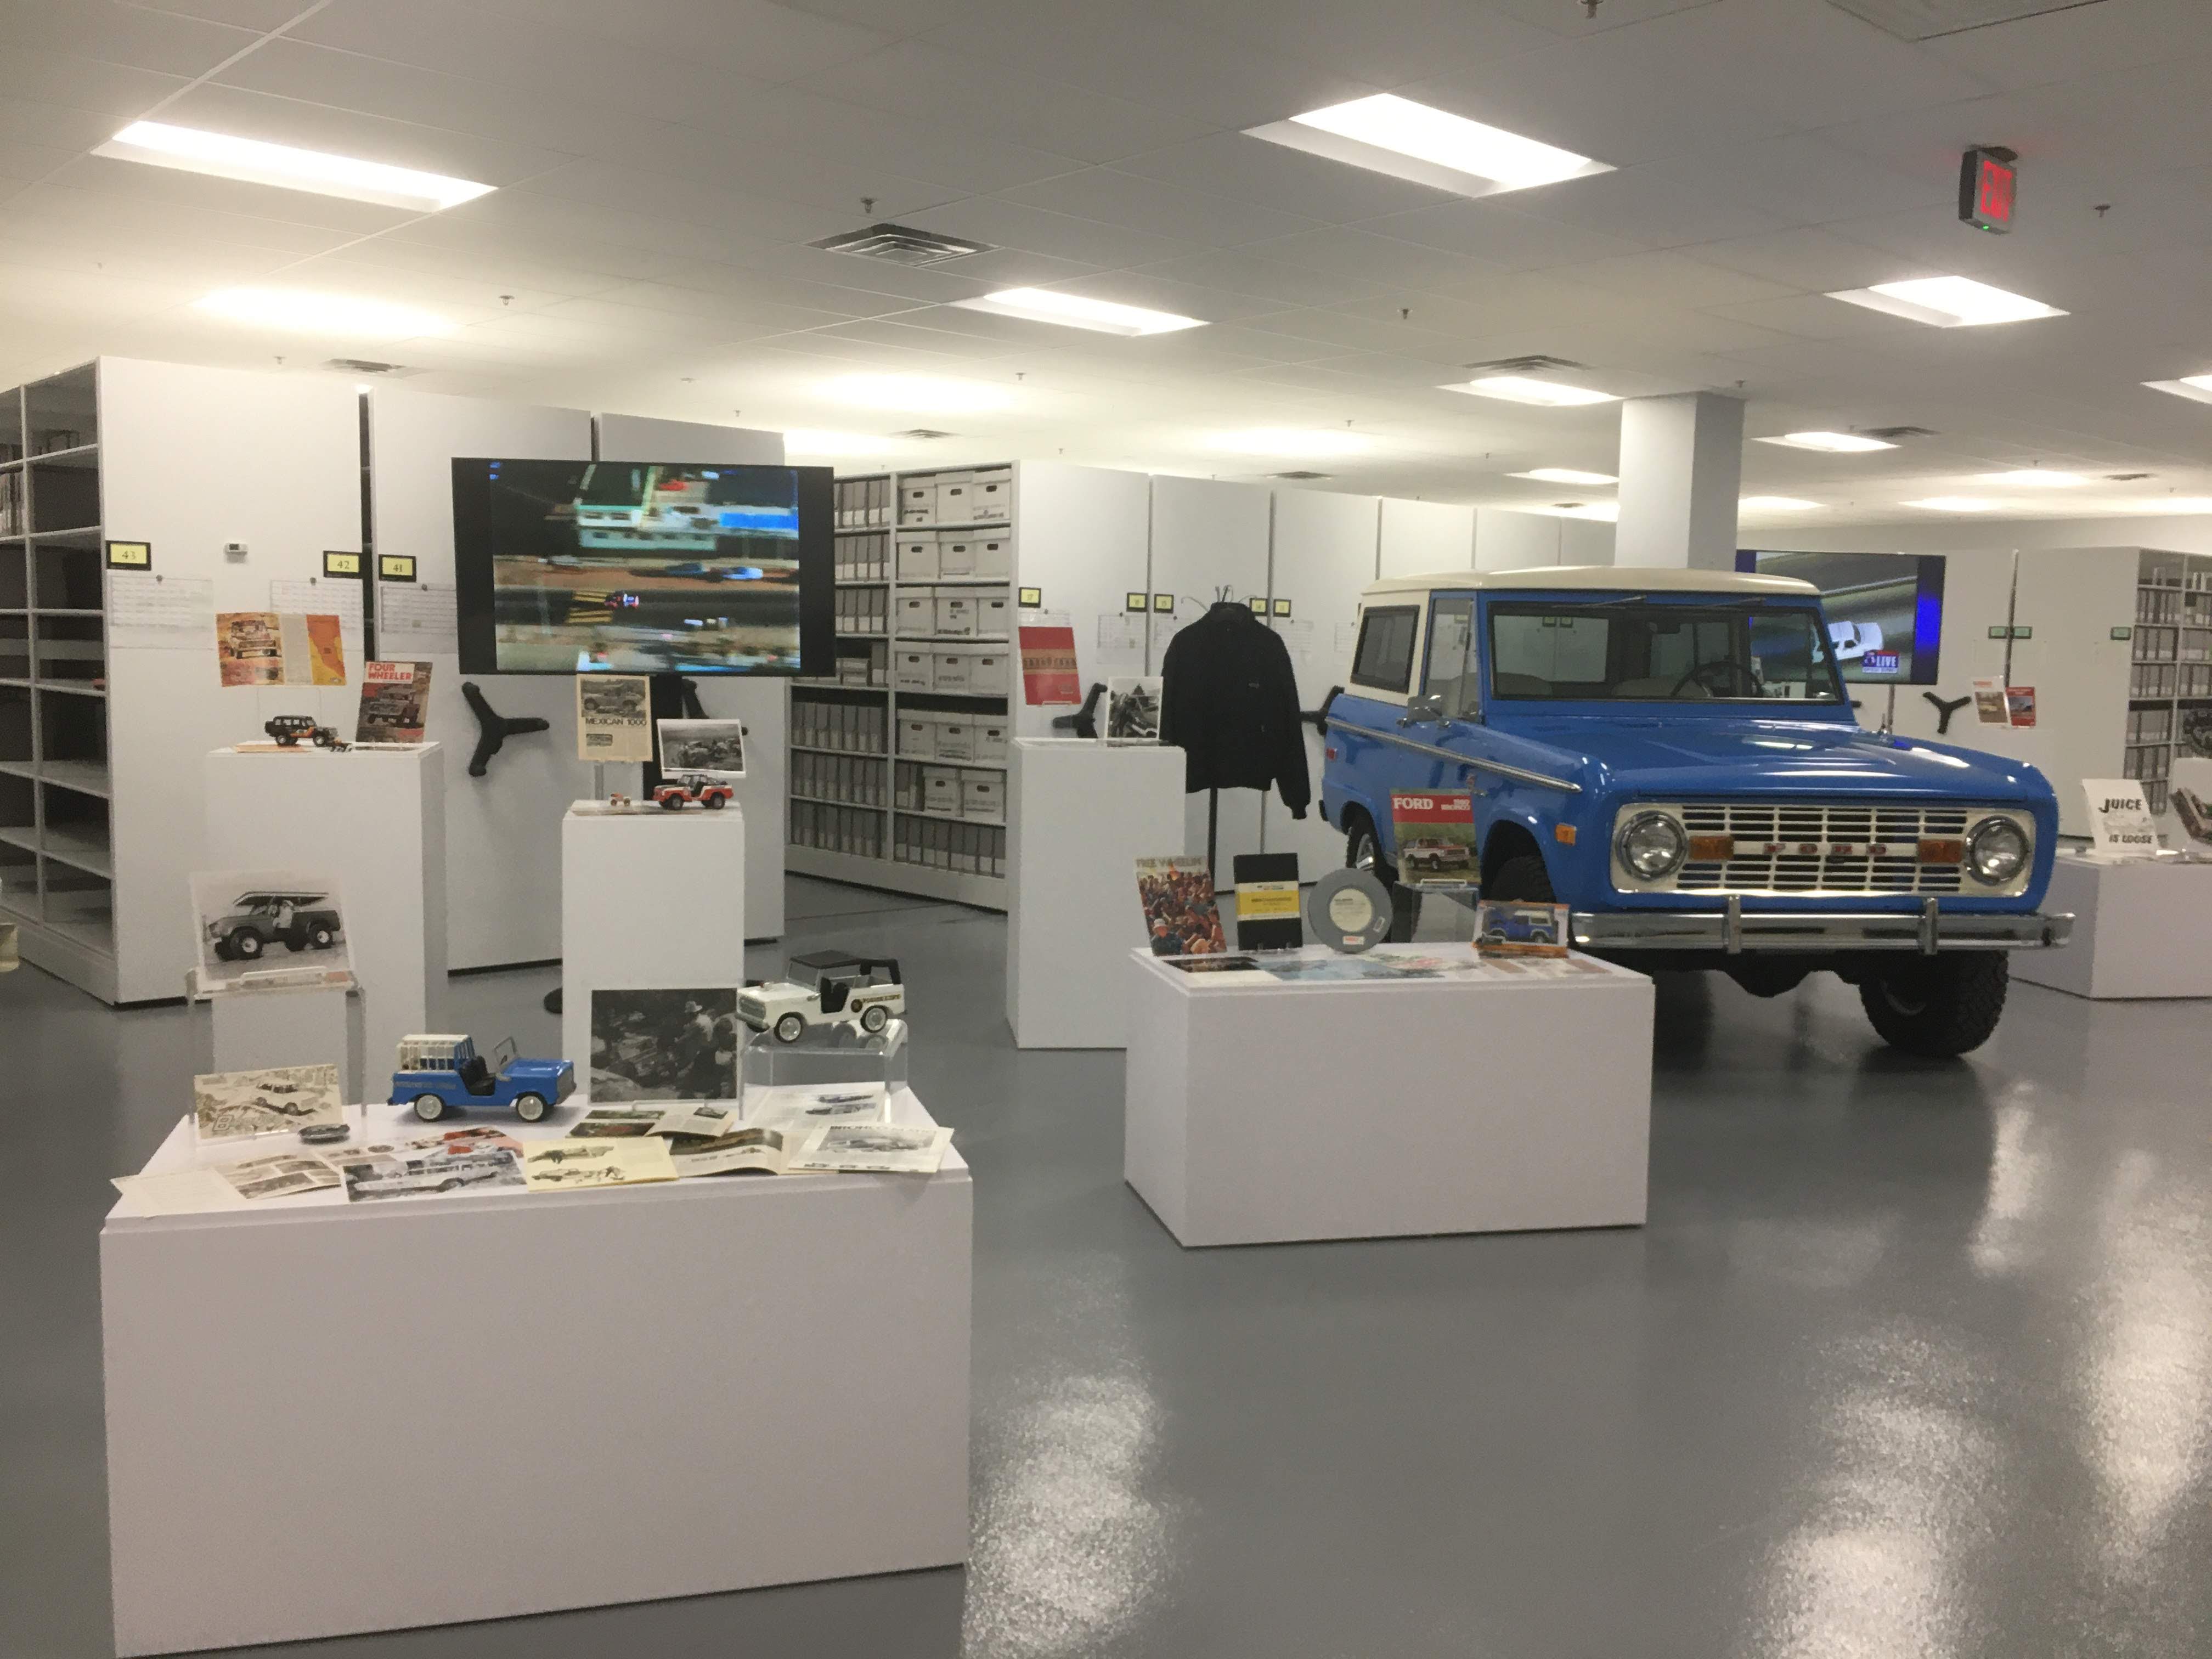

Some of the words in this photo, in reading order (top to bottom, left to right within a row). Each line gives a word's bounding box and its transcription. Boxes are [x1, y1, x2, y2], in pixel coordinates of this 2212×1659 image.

[121, 550, 136, 560] 43
[337, 560, 350, 569] 42
[393, 563, 403, 572] 41
[1876, 656, 1897, 667] LIVE
[368, 663, 396, 672] FOUR
[368, 672, 412, 680] WHEELER
[1392, 797, 1434, 810] FORD
[2098, 798, 2142, 813] JUICE
[2109, 834, 2120, 843] IS
[2122, 834, 2152, 844] LOOSE
[1763, 842, 1887, 855] FORD
